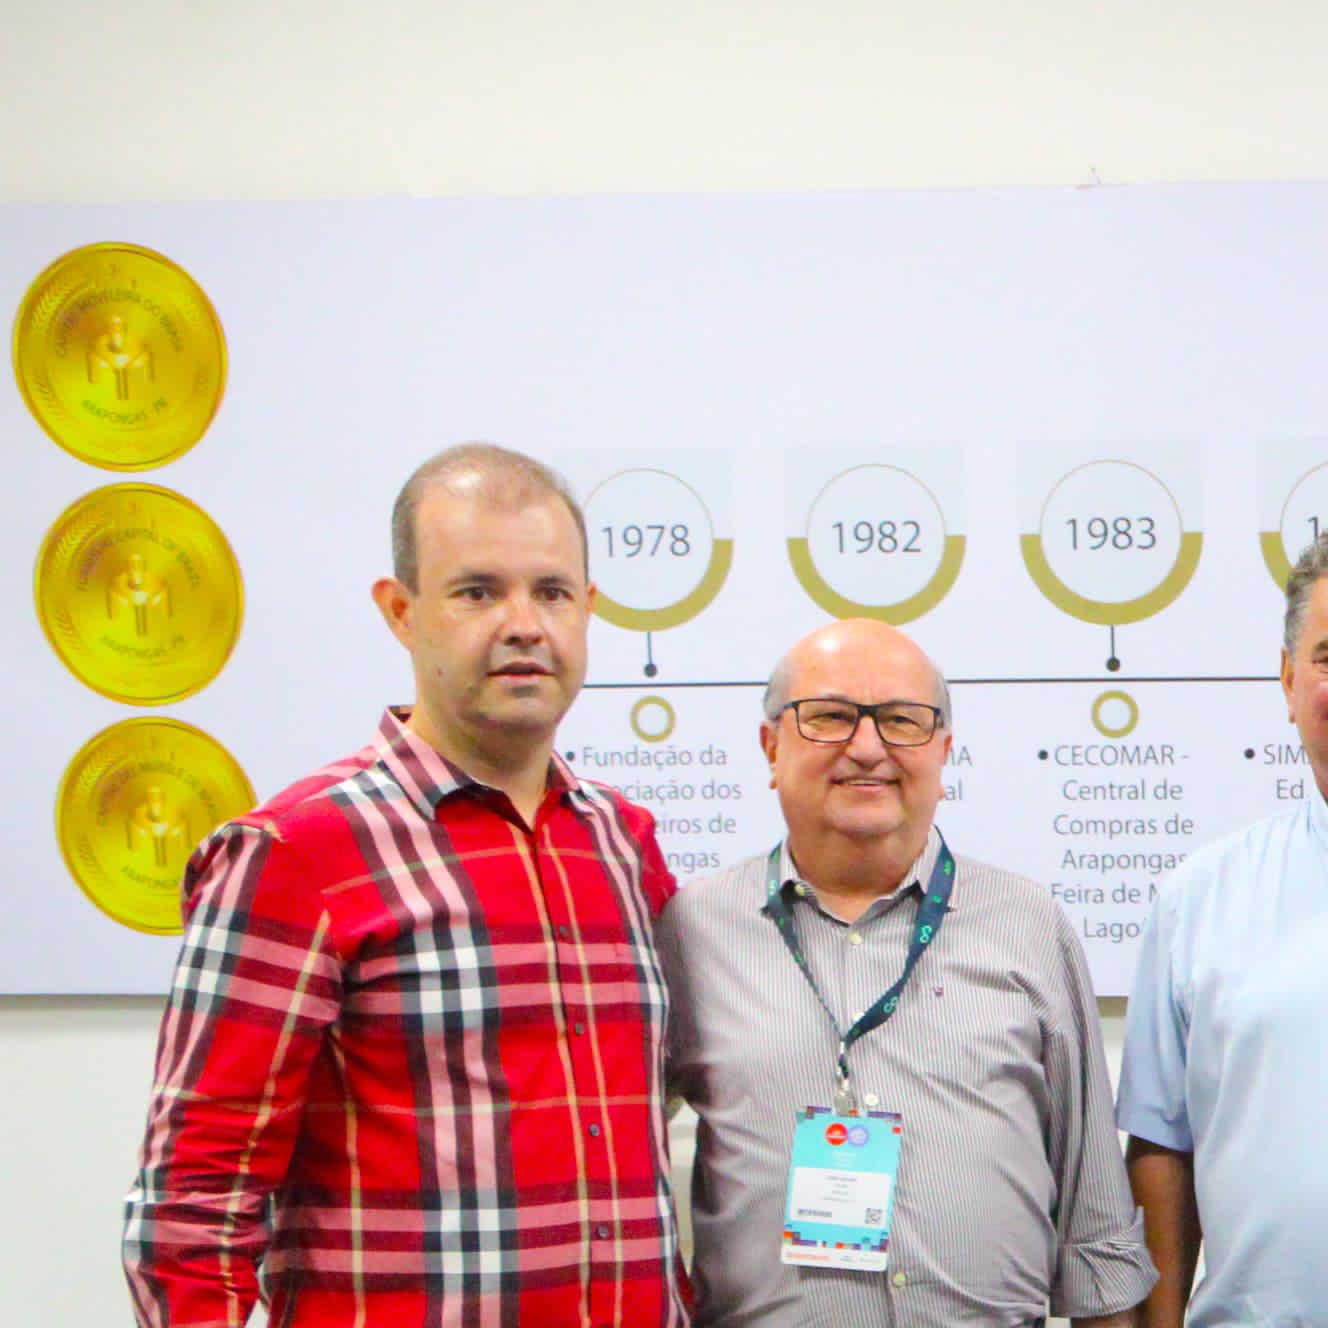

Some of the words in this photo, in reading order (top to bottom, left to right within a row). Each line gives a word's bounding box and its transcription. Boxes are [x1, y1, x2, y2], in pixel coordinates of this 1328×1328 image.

[601, 524, 691, 558] 1978
[832, 521, 922, 555] 1982
[1065, 516, 1157, 551] 1983
[582, 744, 692, 772] Fundação
[700, 743, 727, 766] da
[1054, 744, 1175, 767] CECOMAR
[1263, 743, 1309, 767] SIM
[702, 778, 743, 800] dos
[1062, 777, 1145, 801] Central
[1153, 776, 1183, 801] de
[708, 812, 736, 834] de
[1053, 813, 1158, 840] Compras
[1165, 812, 1194, 835] de
[1050, 882, 1105, 904] Feira
[1111, 881, 1141, 904] de
